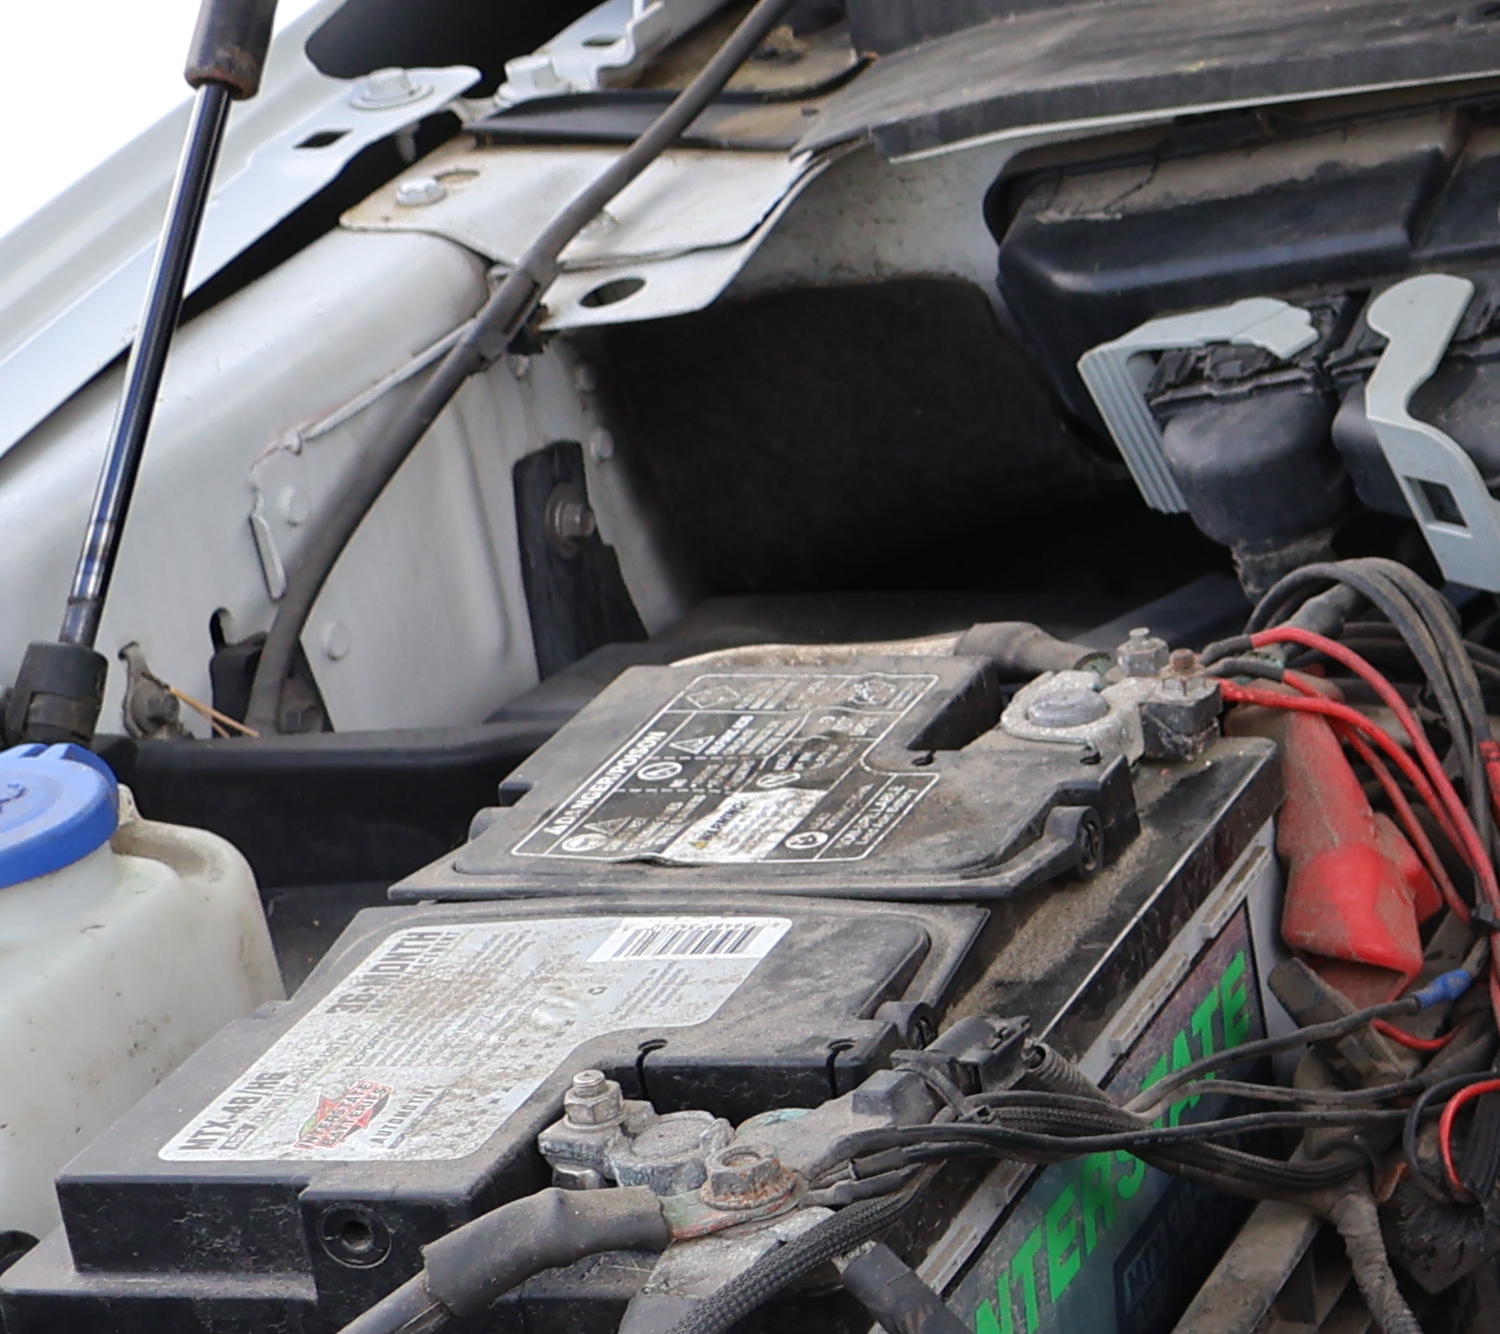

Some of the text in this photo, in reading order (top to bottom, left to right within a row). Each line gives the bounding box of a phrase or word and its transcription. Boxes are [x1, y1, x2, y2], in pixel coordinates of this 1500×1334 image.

[553, 731, 668, 824] DANGER/POISON
[324, 931, 442, 1014] 36-MONTH
[178, 1072, 290, 1150] MTX-48/H6
[297, 1081, 374, 1148] INTERSTATE
[316, 1085, 392, 1147] BATTERIES
